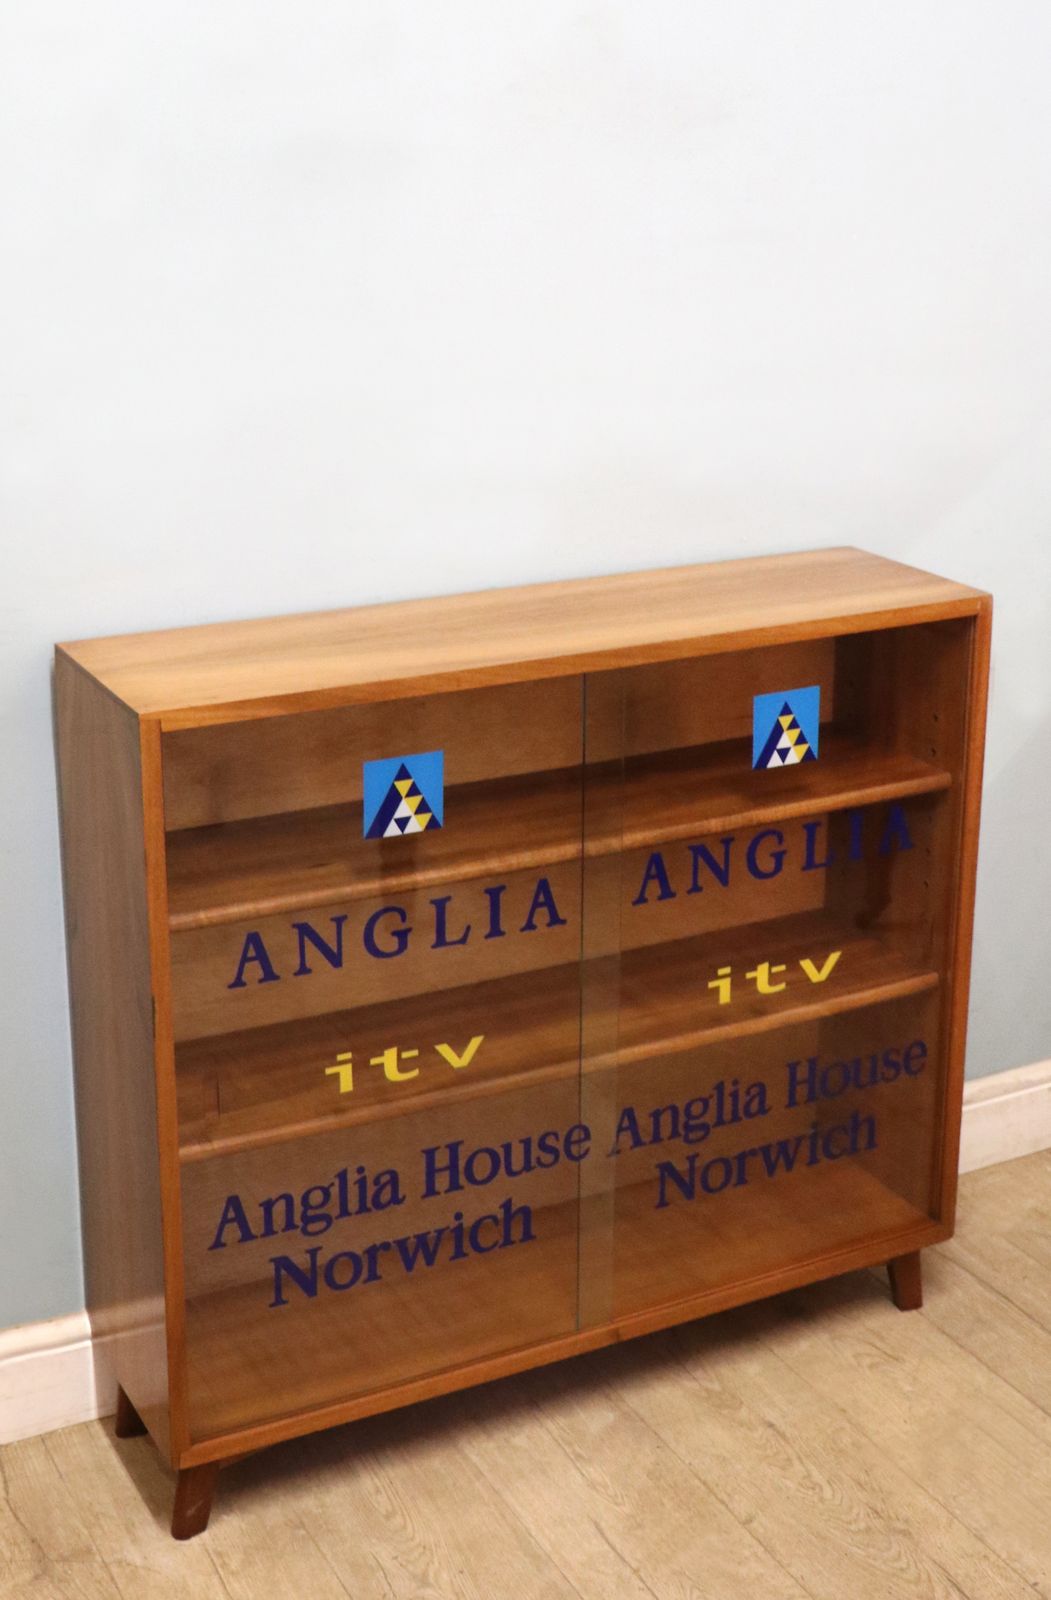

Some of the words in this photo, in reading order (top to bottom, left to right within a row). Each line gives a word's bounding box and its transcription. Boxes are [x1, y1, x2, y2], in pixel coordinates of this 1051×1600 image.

[632, 804, 915, 906] ANGLIA
[227, 878, 567, 989] ANGLIA
[708, 950, 842, 1005] itv
[324, 1035, 485, 1094] itv
[606, 1078, 768, 1158] Anglia
[785, 1038, 927, 1108] House
[207, 1165, 406, 1251] Anglia
[420, 1118, 591, 1201] House
[654, 1109, 878, 1209] Norwich
[268, 1198, 536, 1308] Norwich
